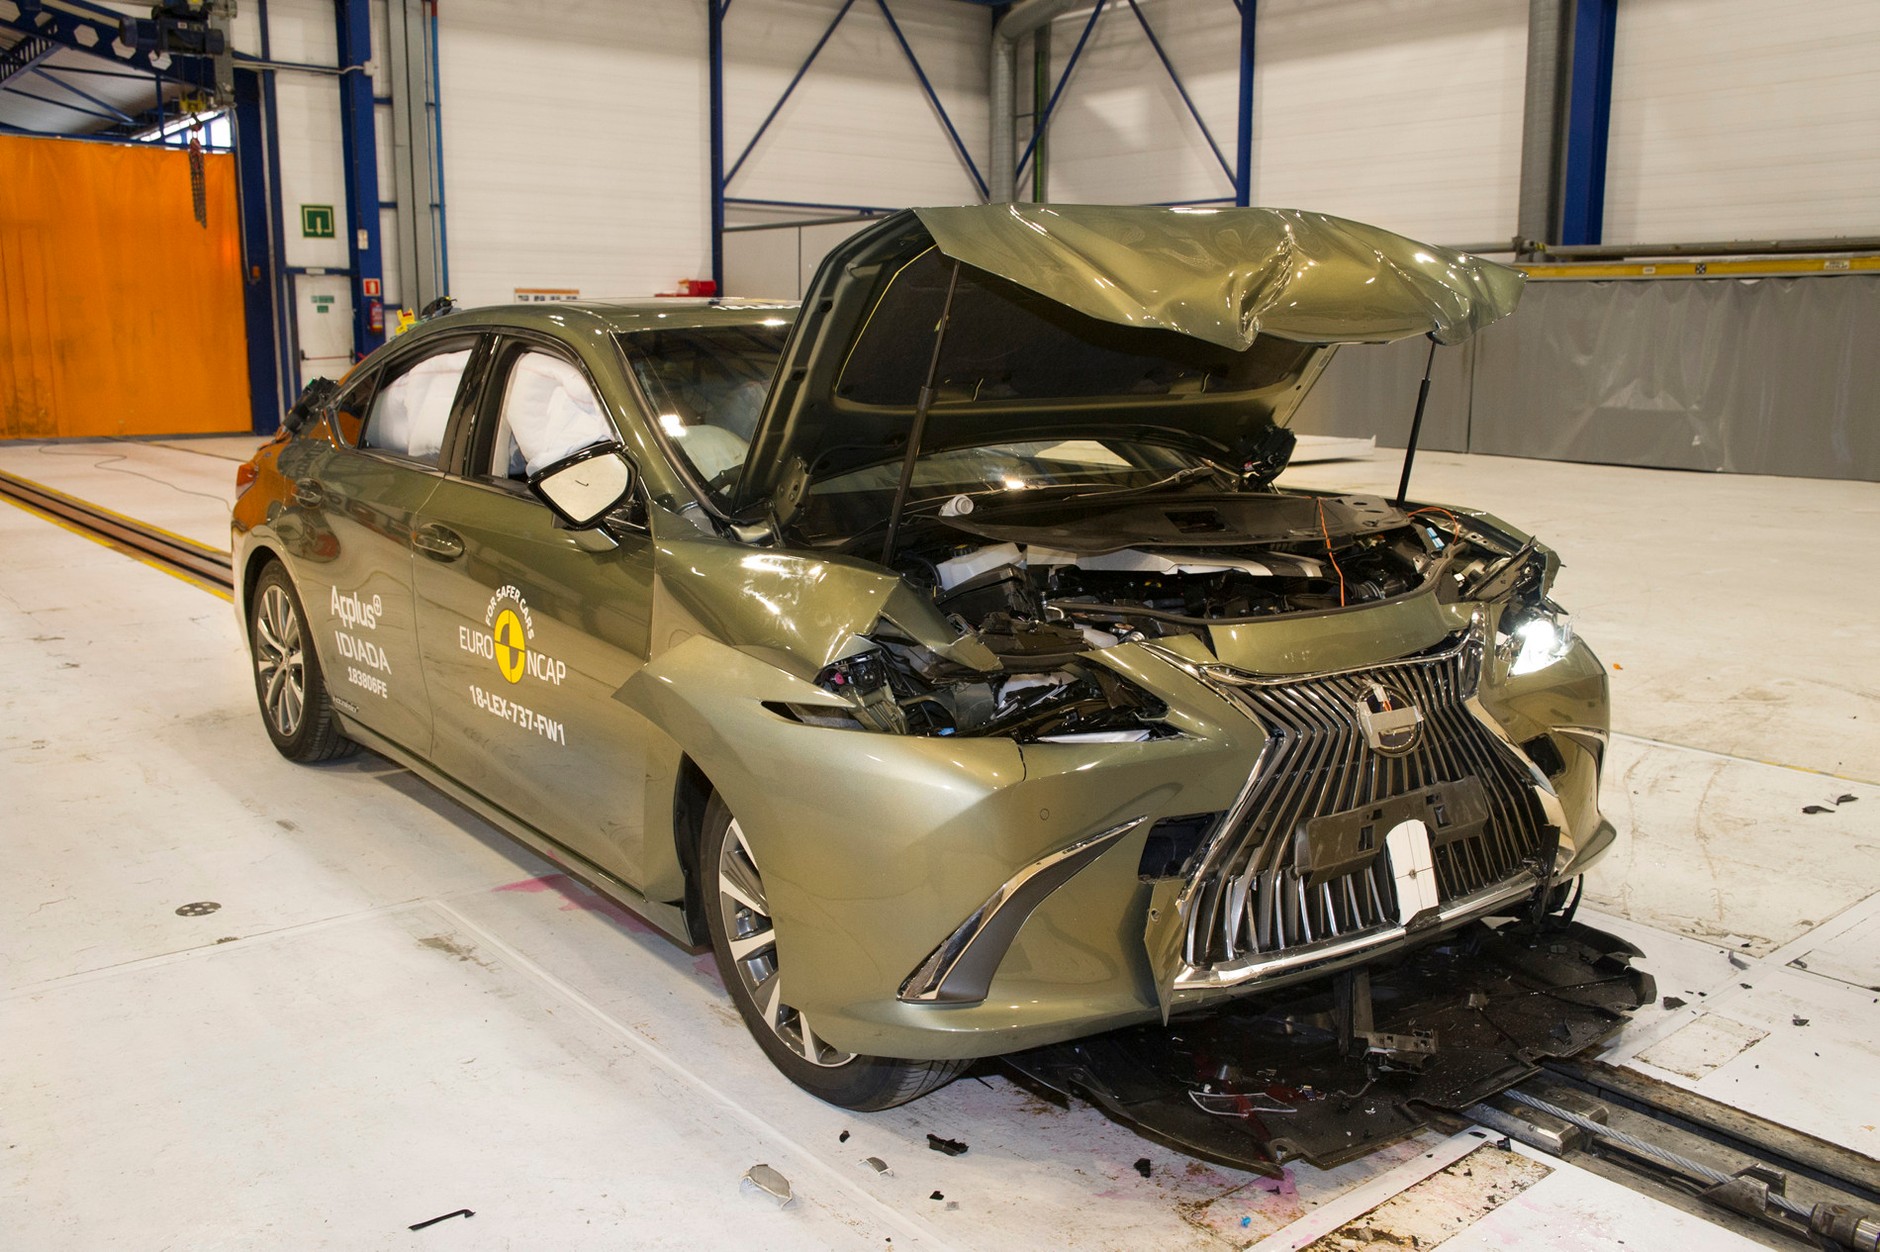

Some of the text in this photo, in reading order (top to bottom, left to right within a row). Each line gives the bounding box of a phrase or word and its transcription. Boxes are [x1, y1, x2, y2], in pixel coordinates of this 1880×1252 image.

[331, 585, 377, 630] Applus
[485, 585, 535, 640] FOR SAFER CARS
[335, 631, 392, 675] IDIADA
[459, 625, 567, 686] EURO NCAP
[347, 666, 388, 699] 183806FE
[469, 685, 566, 746] 18-LEX-737-FW1
